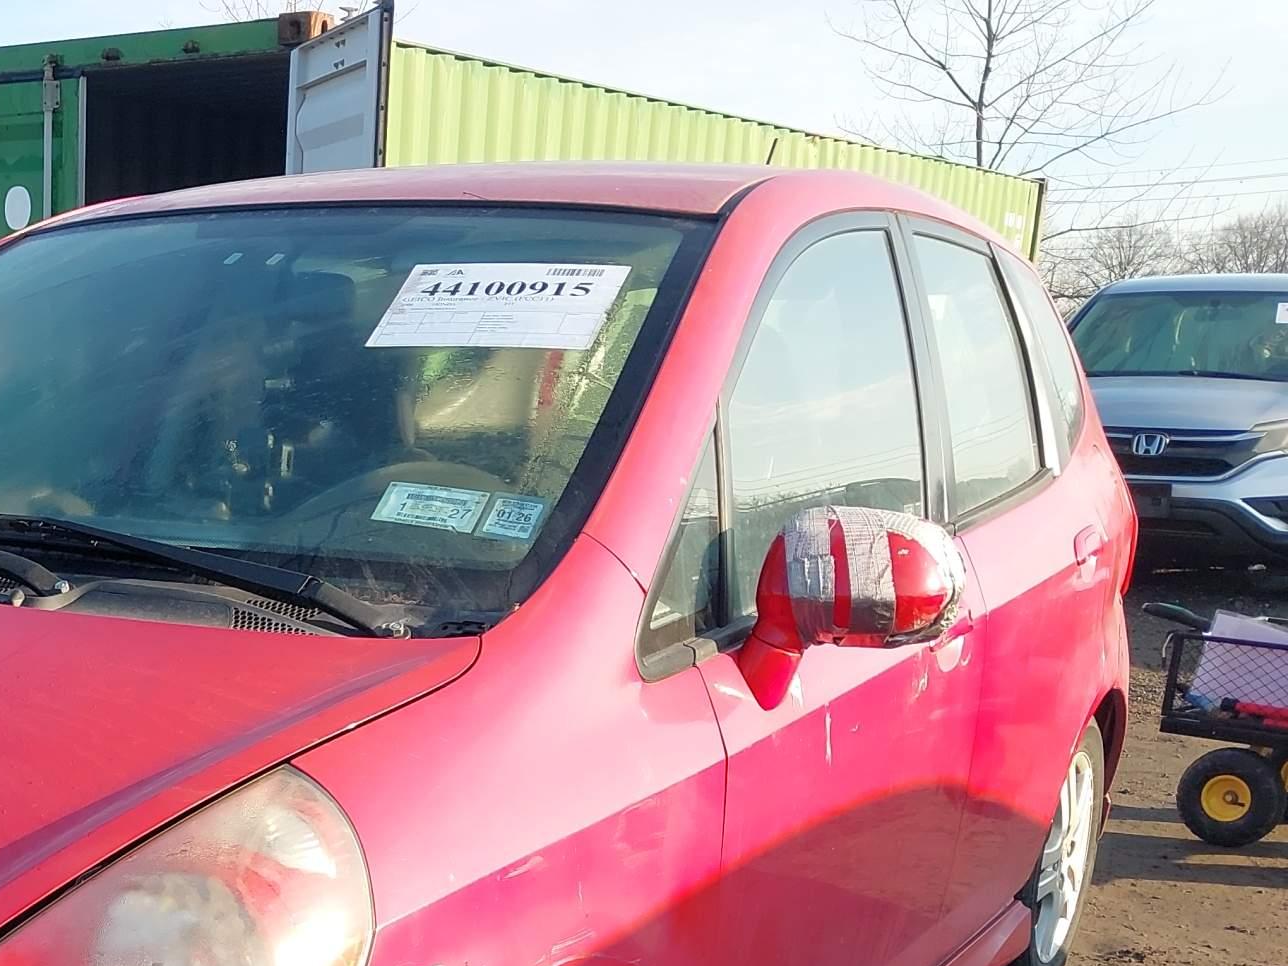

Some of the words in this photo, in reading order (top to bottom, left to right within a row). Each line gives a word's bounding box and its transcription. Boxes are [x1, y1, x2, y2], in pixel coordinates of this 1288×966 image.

[420, 281, 593, 296] 44100915
[448, 508, 473, 520] 27
[515, 512, 533, 523] 26
